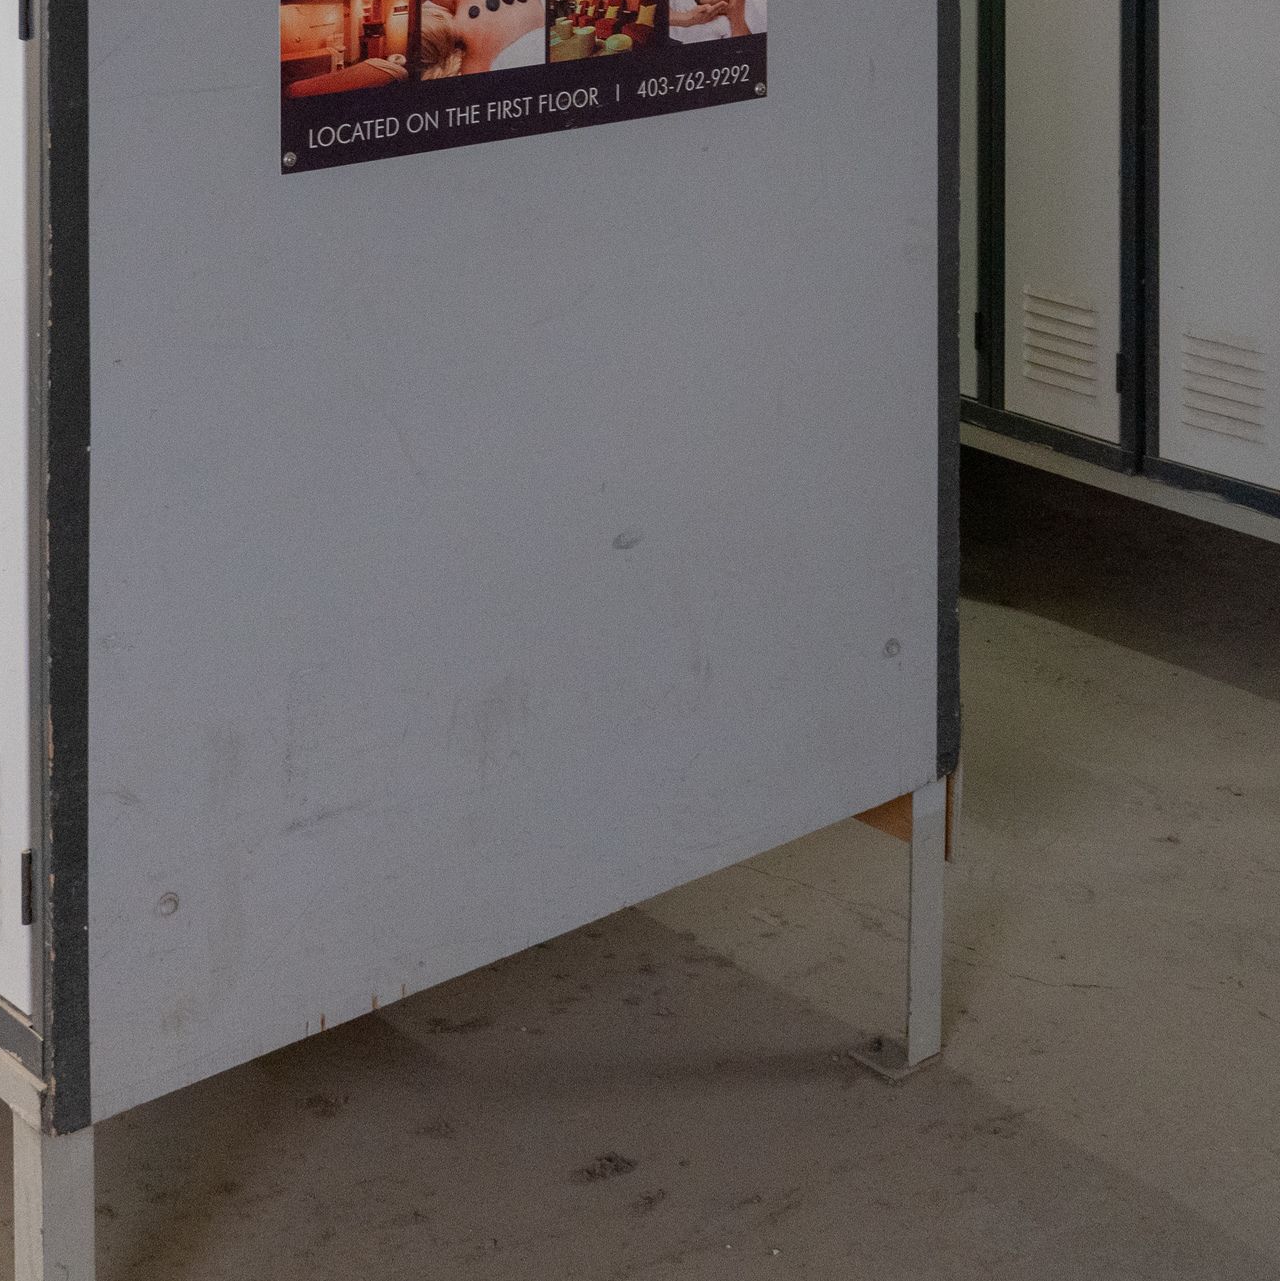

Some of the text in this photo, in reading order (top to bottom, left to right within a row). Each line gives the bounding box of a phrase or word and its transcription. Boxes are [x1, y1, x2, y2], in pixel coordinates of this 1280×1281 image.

[308, 64, 750, 149] LOCATED ON THE FIRST FLOOR 403-762-9292
